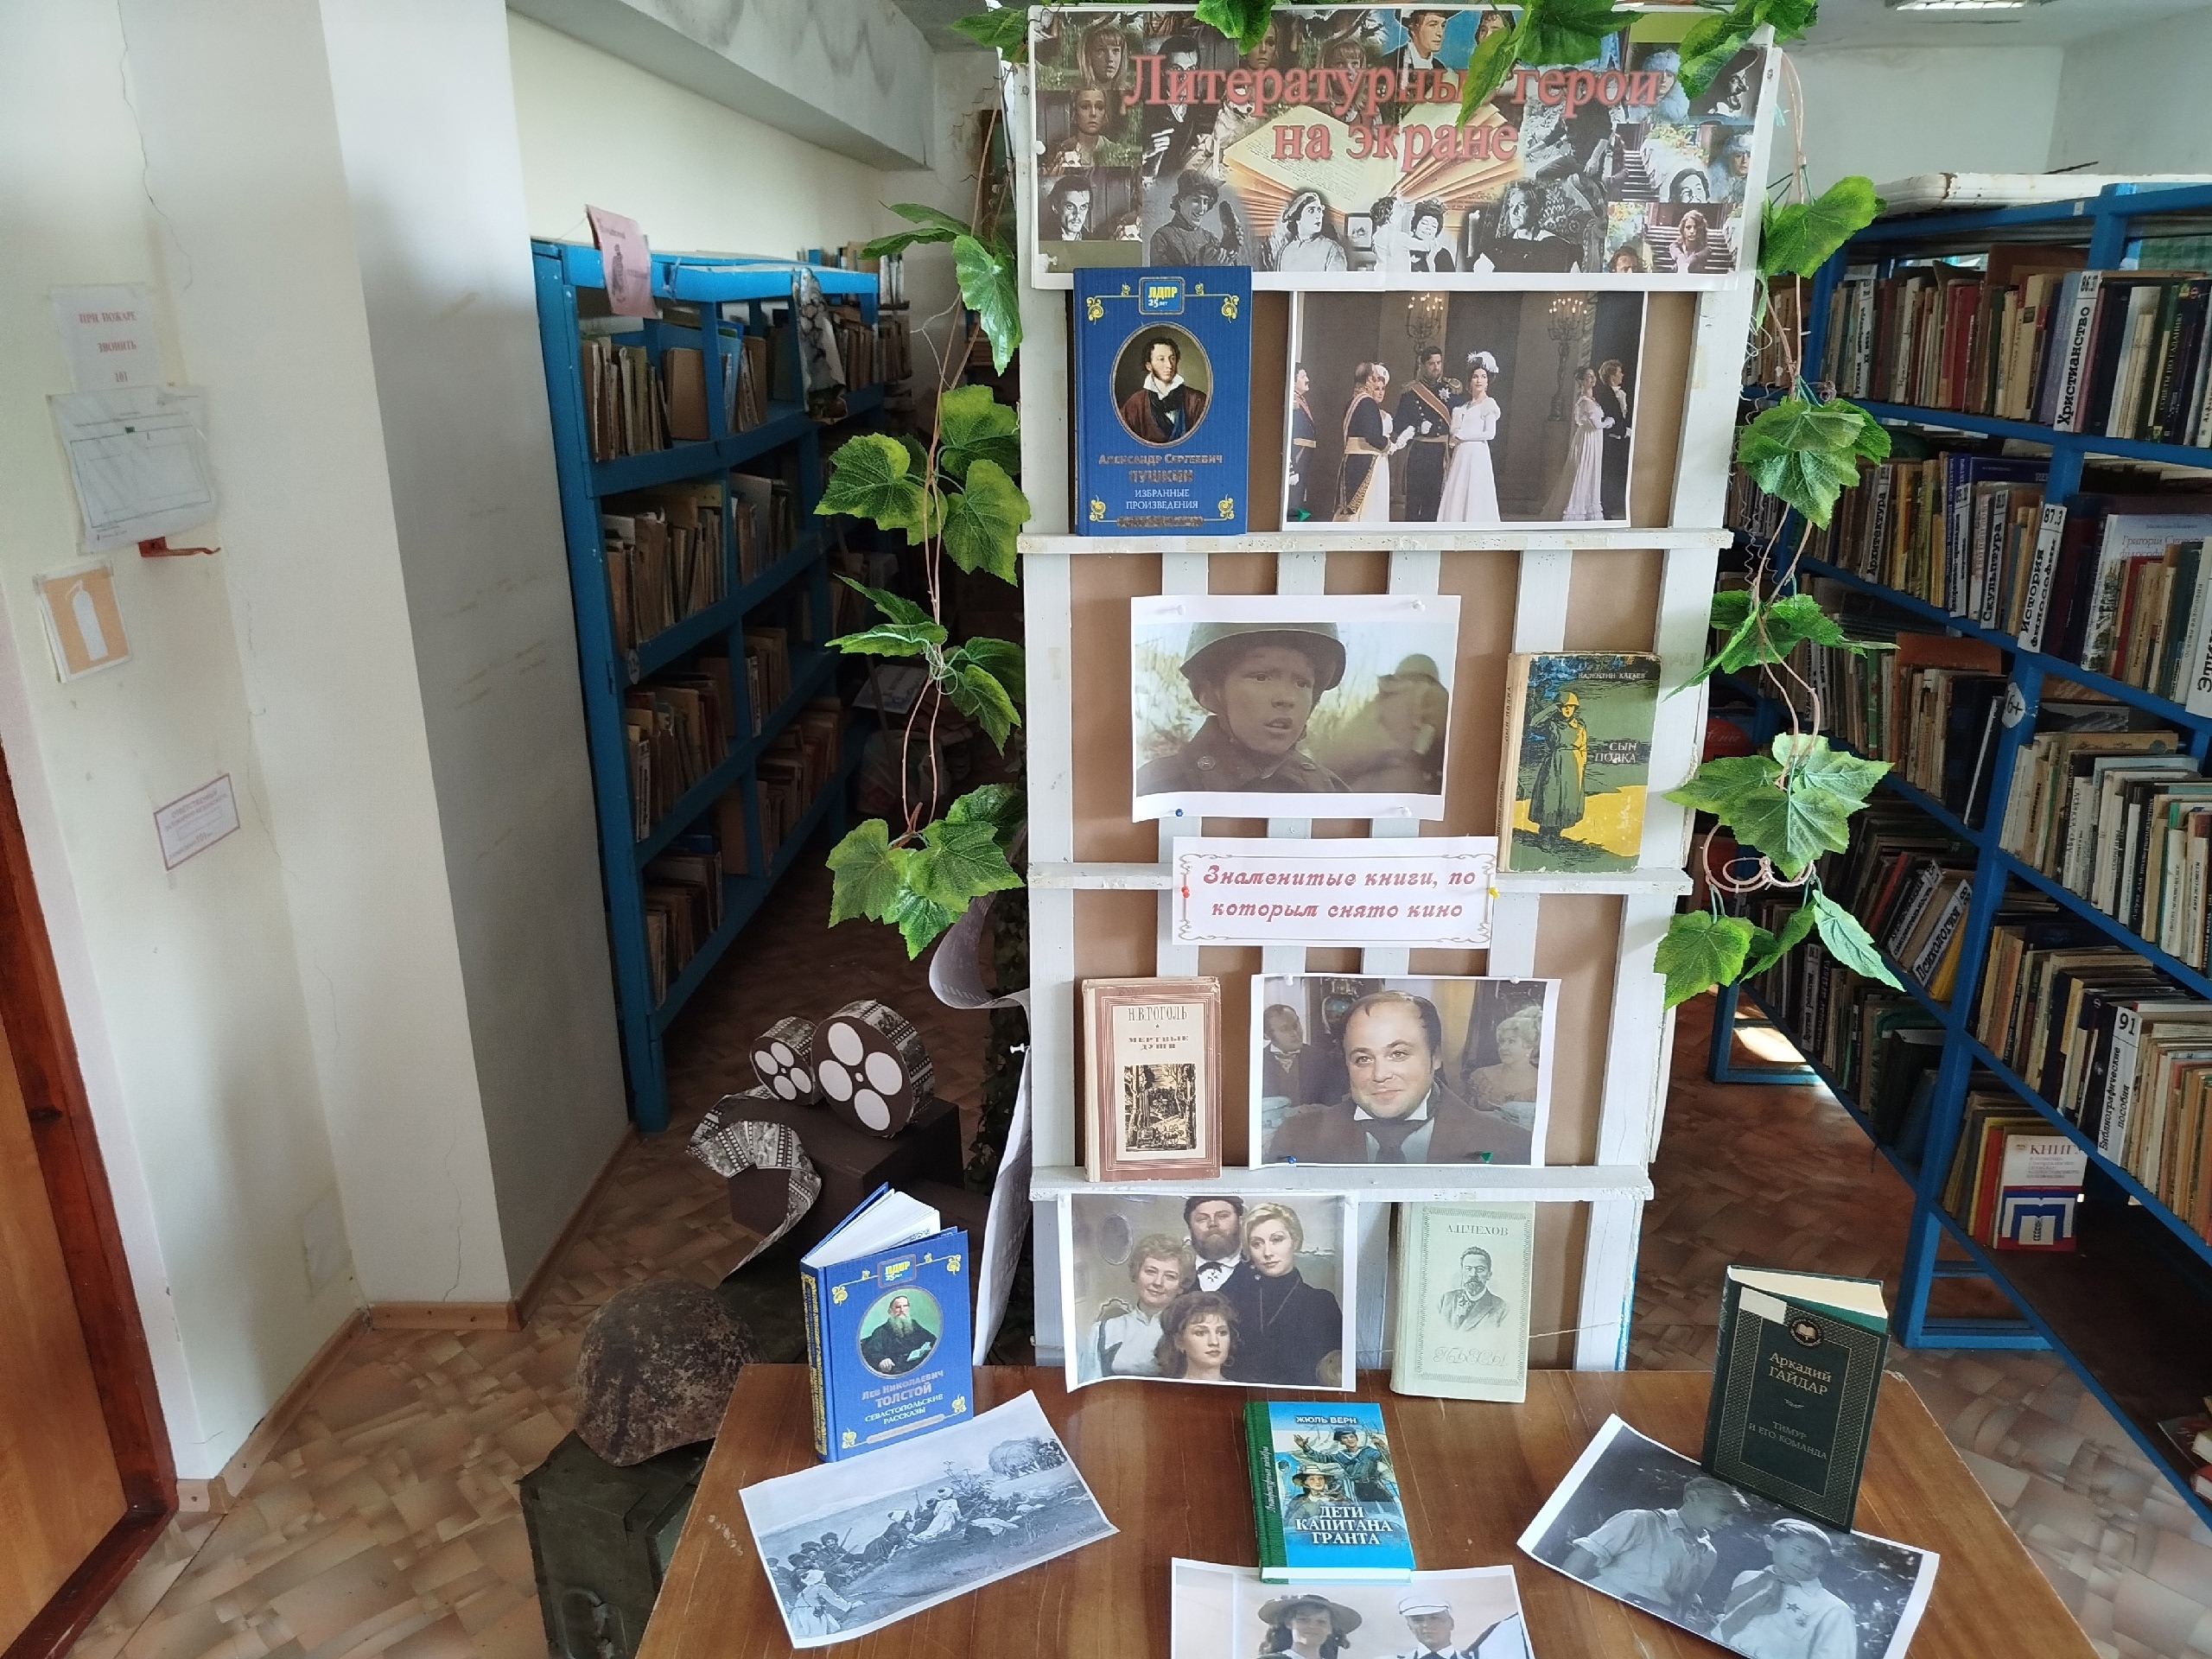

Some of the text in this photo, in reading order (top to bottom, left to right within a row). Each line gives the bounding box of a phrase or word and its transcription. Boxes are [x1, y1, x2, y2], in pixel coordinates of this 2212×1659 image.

[1124, 54, 1663, 119] Литературны герои
[1271, 124, 1519, 174] на экране
[1147, 286, 1179, 301] ЛДПР
[1147, 298, 1159, 308] 25
[78, 311, 137, 324] ПРИ ПОЖАРЕ
[98, 340, 137, 353] ЗВОНИТЬ
[2056, 306, 2091, 425] Христианство
[2160, 313, 2183, 410] СОВЕТЫ ПО ГАДАНИЮ
[114, 371, 128, 383] 101
[1128, 469, 1193, 483] ПУШКИН
[1135, 488, 1190, 498] ИЗБРАННЫЕ
[1126, 500, 1198, 510] ПРОИЗВЕДЕНИЯ
[2044, 507, 2064, 527] 87.3
[1866, 492, 1886, 576] Архитектура
[1982, 522, 2002, 622] Скульптура
[2020, 549, 2044, 632] История
[1579, 671, 1647, 680] ВАЛЕНТИН КАТАЕВ
[1609, 741, 1637, 752] СЫН
[1594, 753, 1637, 764] ПОЛКА
[2069, 787, 2080, 830] Леонардо
[1203, 864, 1476, 888] Знаменитые книги, по
[1211, 902, 1464, 922] которым снято кино
[1916, 906, 1961, 982] Психология
[2118, 1013, 2135, 1036] 91
[1128, 1035, 1189, 1044] МЕРТВЫЕ
[2098, 1046, 2121, 1151] Библиографические
[2118, 1084, 2130, 1128] пособия
[2030, 1144, 2079, 1155] КНИГ
[885, 1261, 911, 1275] ЛДПР
[1769, 1351, 1832, 1383] Аркадий
[1769, 1364, 1828, 1396] ГАЙДАР
[875, 1381, 932, 1408] ТОЛСТОЙ
[864, 1393, 944, 1422] СЕВАСТОПОЛЬСКИЕ
[883, 1406, 926, 1425] РАССКАЗЫ
[1296, 1415, 1357, 1425] ЖЮЛЬ ВЕРН
[1772, 1421, 1808, 1440] ТИМУР
[1748, 1422, 1828, 1460] И ЕГО КОМАНДА
[1262, 1465, 1277, 1513] Литературные
[1319, 1505, 1364, 1519] ДЕТИ
[1295, 1519, 1394, 1532] КАПИТАНА
[1312, 1531, 1381, 1545] ГРАНТА
